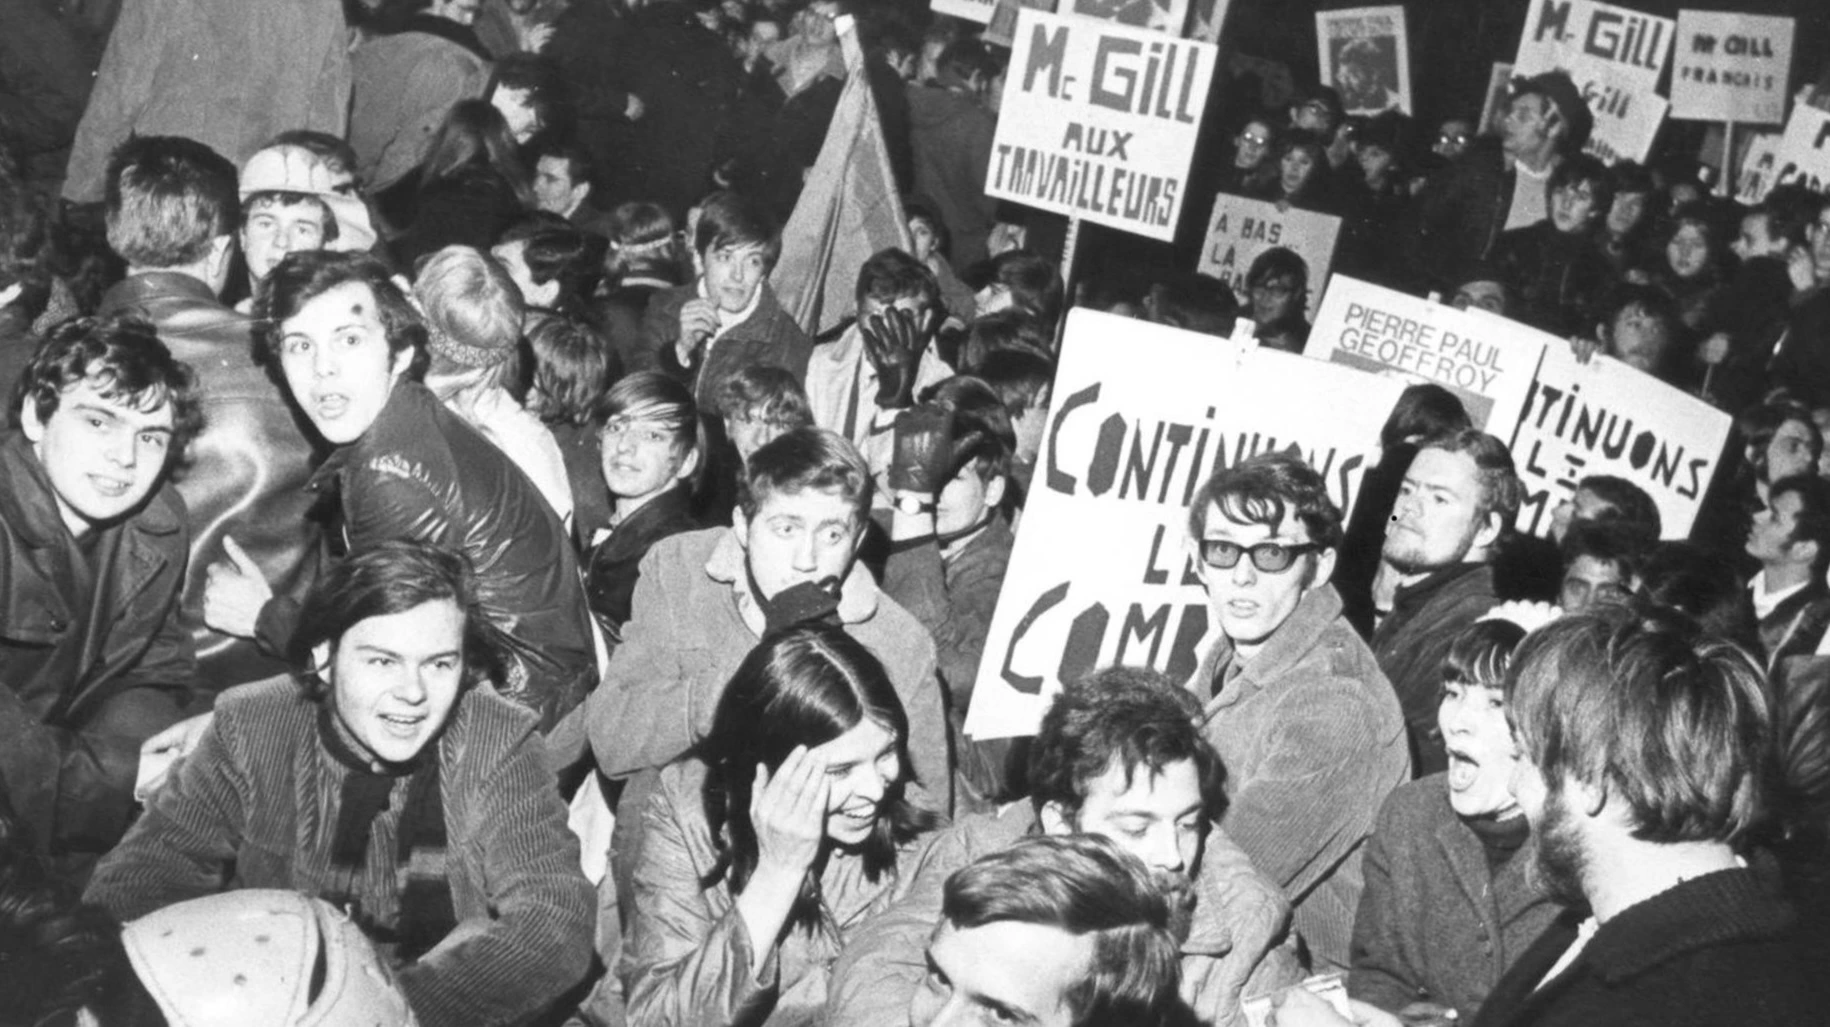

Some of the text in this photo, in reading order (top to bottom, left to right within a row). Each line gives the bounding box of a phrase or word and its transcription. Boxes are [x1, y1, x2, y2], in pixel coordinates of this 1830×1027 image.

[1062, 122, 1133, 161] AUX
[1215, 213, 1228, 233] A
[1211, 243, 1235, 267] LA
[1340, 327, 1496, 392] GEOFFROY
[1344, 303, 1504, 372] PIERRE PAUL
[1000, 581, 1209, 695] COMB
